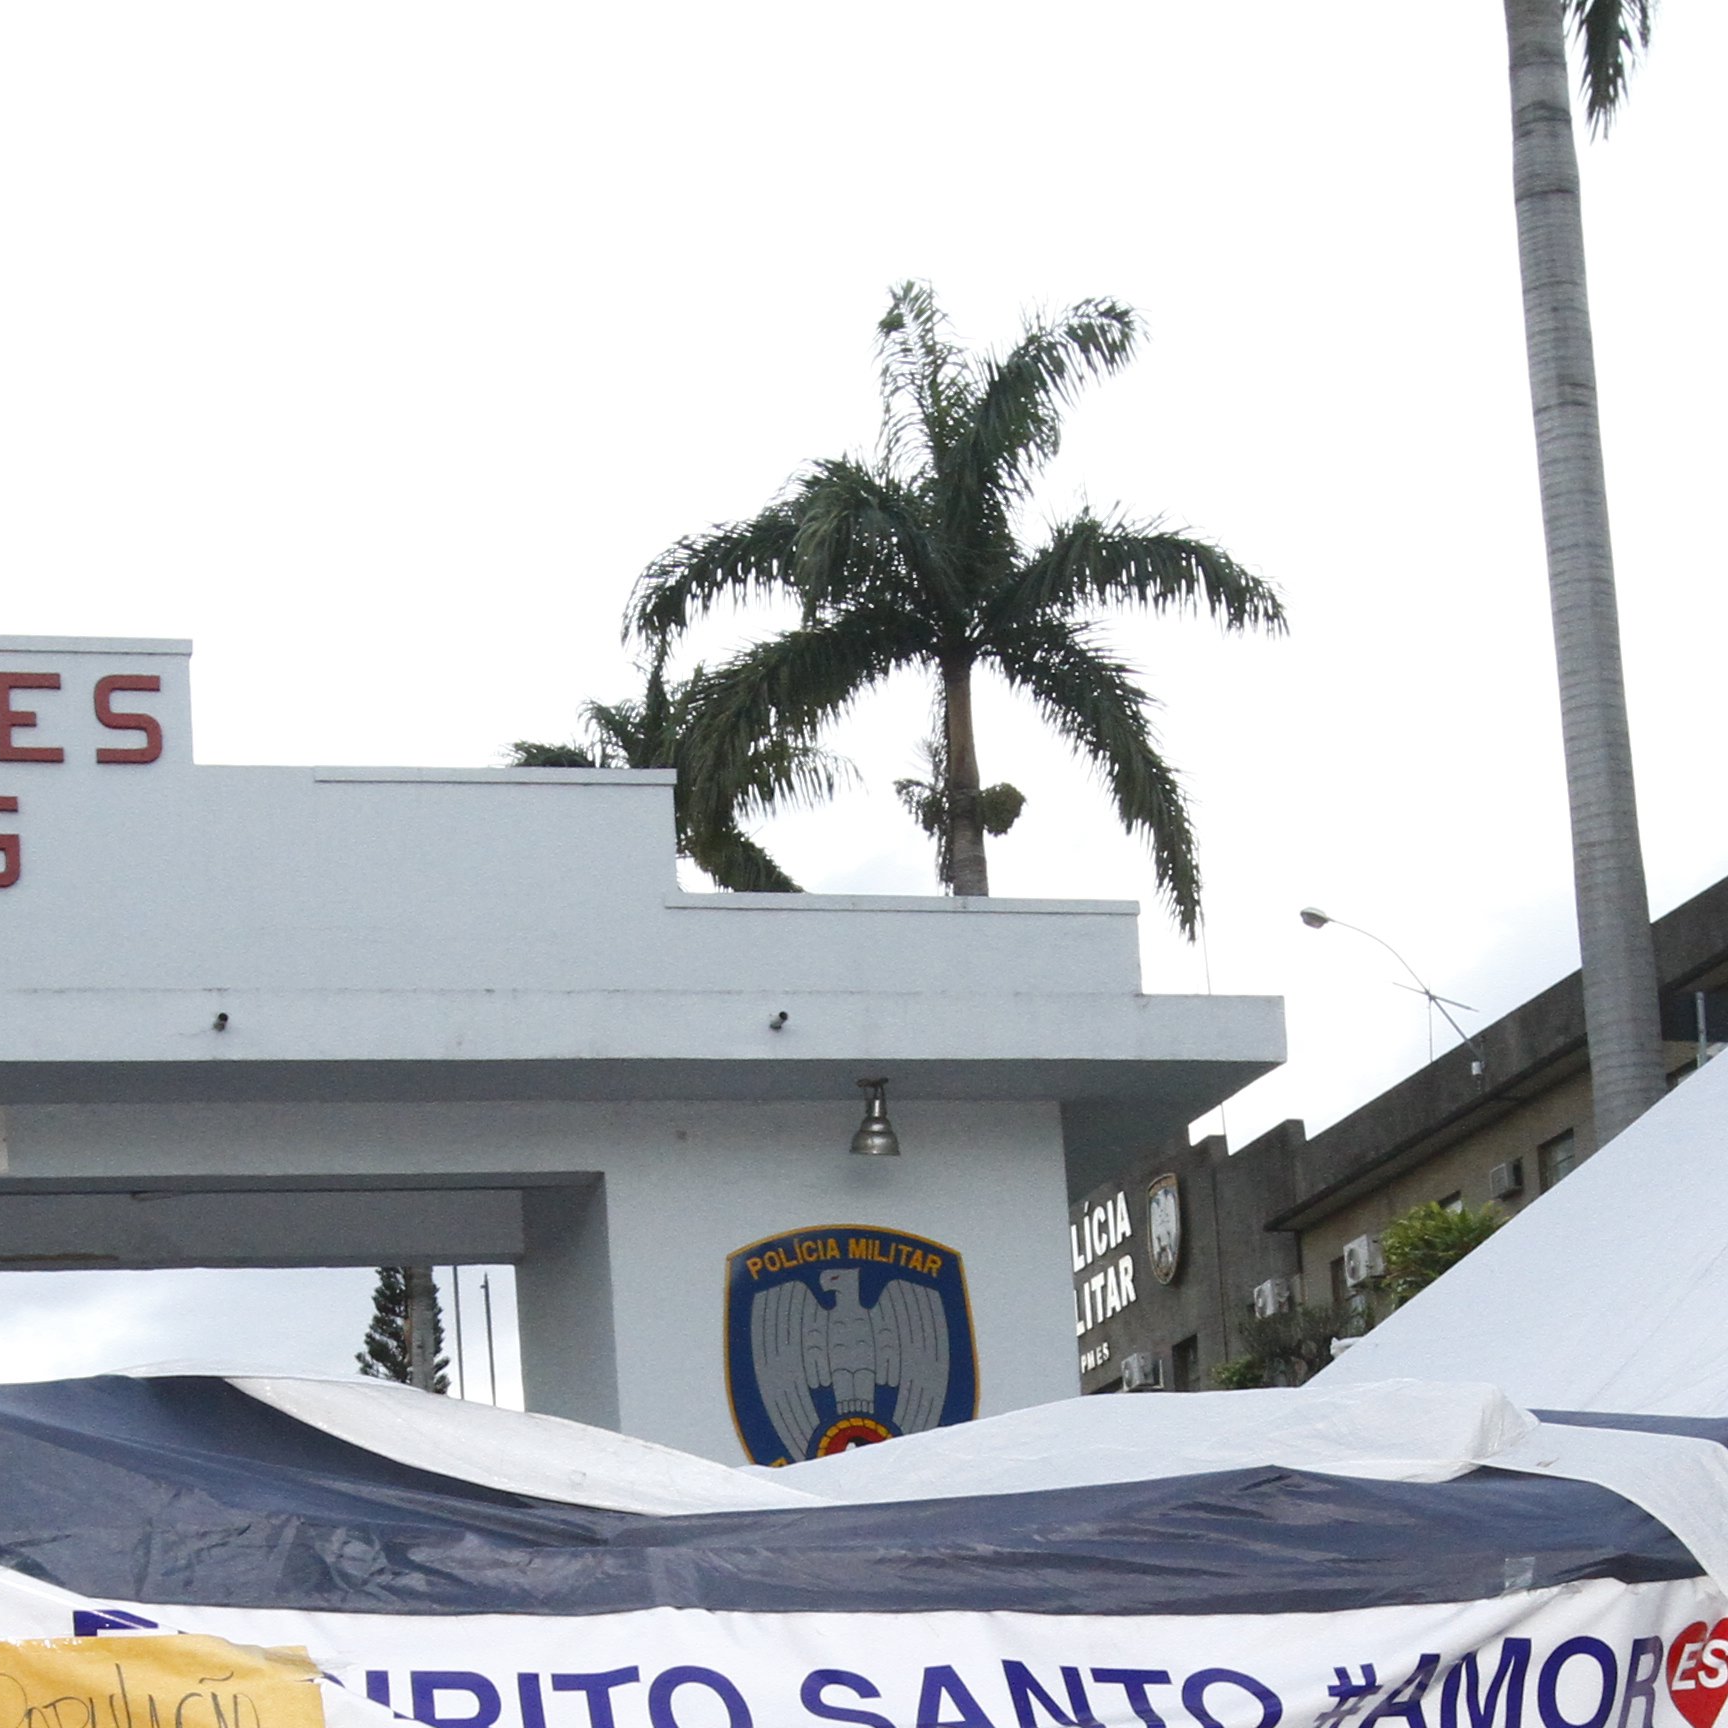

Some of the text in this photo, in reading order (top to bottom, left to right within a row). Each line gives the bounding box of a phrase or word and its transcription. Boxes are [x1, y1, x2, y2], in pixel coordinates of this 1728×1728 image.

[745, 1238, 943, 1280] POLÍCIA MILITAR
[1070, 1190, 1133, 1274] LÍCIA
[1073, 1254, 1137, 1337] LITAR
